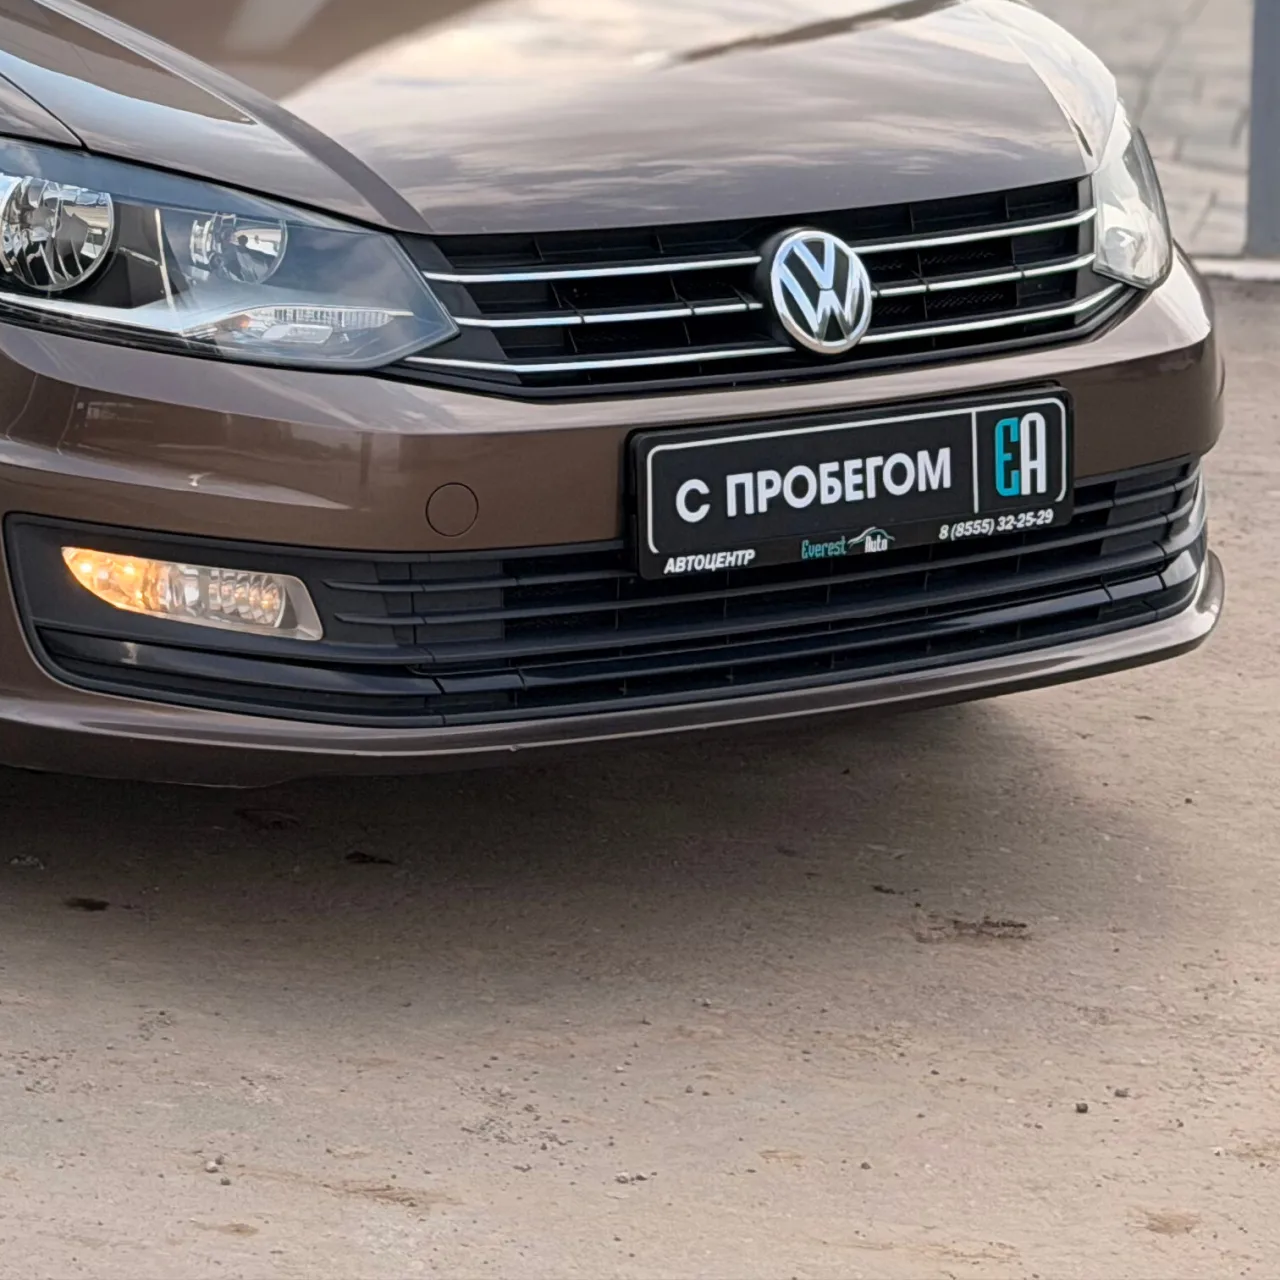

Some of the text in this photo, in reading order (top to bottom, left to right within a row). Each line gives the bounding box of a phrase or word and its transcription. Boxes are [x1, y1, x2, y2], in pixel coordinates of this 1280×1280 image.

[676, 447, 952, 524] С ПРОБЕГОМ
[938, 508, 1054, 541] 8 (8555) 32-25-29
[663, 548, 756, 575] АВТОЦЕНТР
[801, 535, 888, 559] Everest Auto
